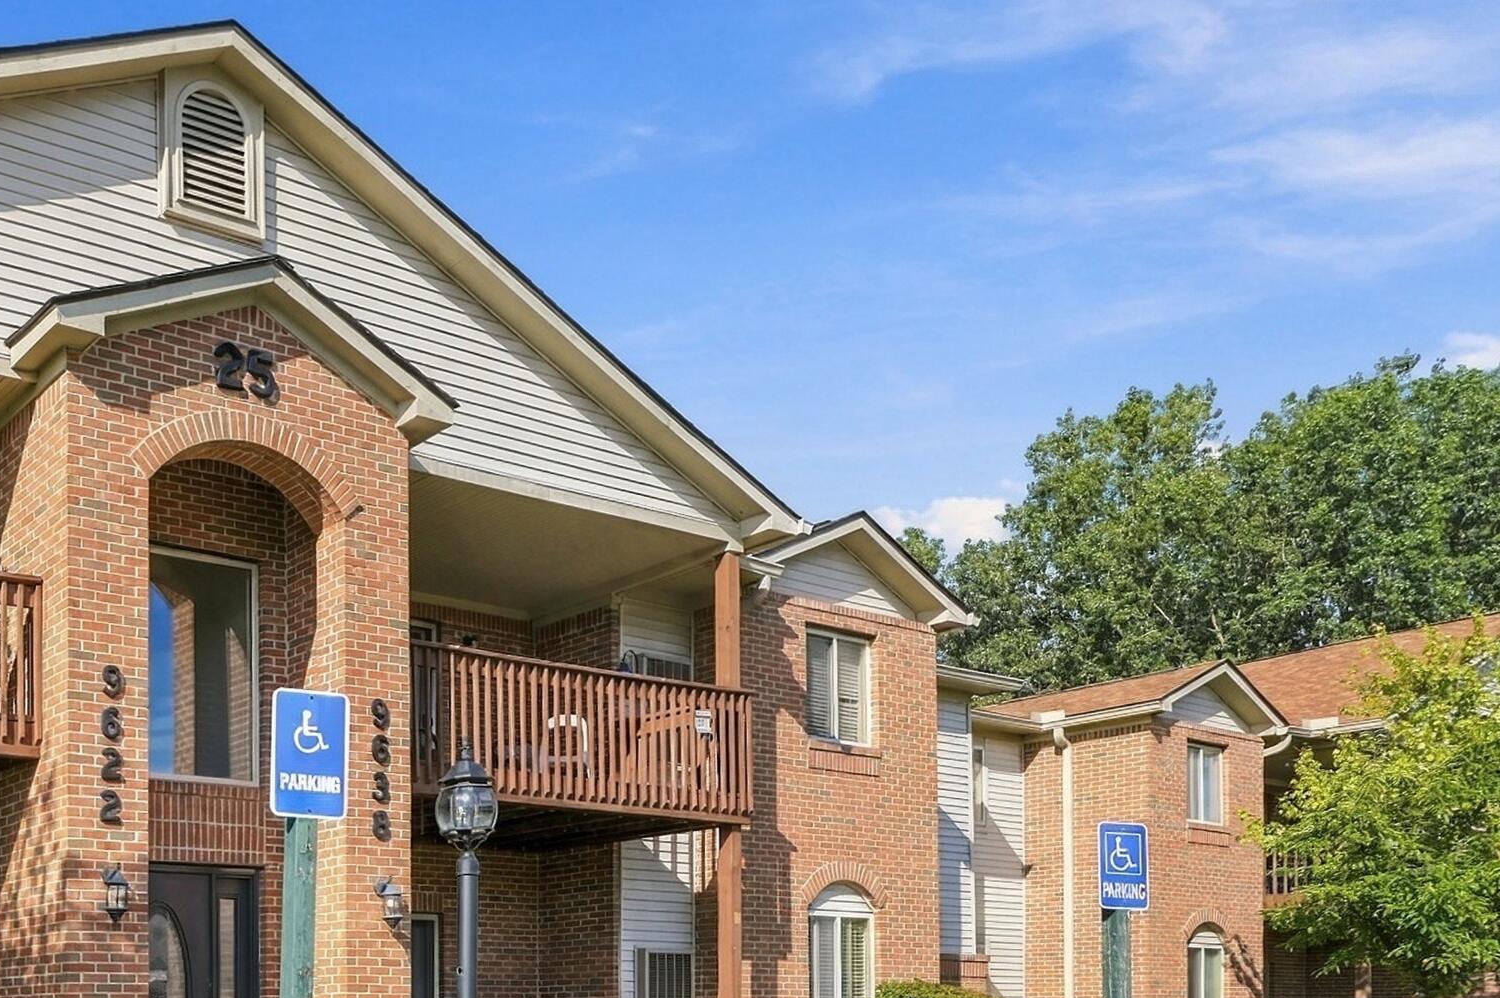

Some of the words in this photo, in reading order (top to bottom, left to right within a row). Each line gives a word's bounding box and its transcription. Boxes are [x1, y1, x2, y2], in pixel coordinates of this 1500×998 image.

[214, 342, 278, 401] 25
[100, 664, 124, 827] 9622
[371, 698, 391, 843] 9638
[279, 771, 341, 795] PARKING
[1102, 881, 1147, 900] PARKING
